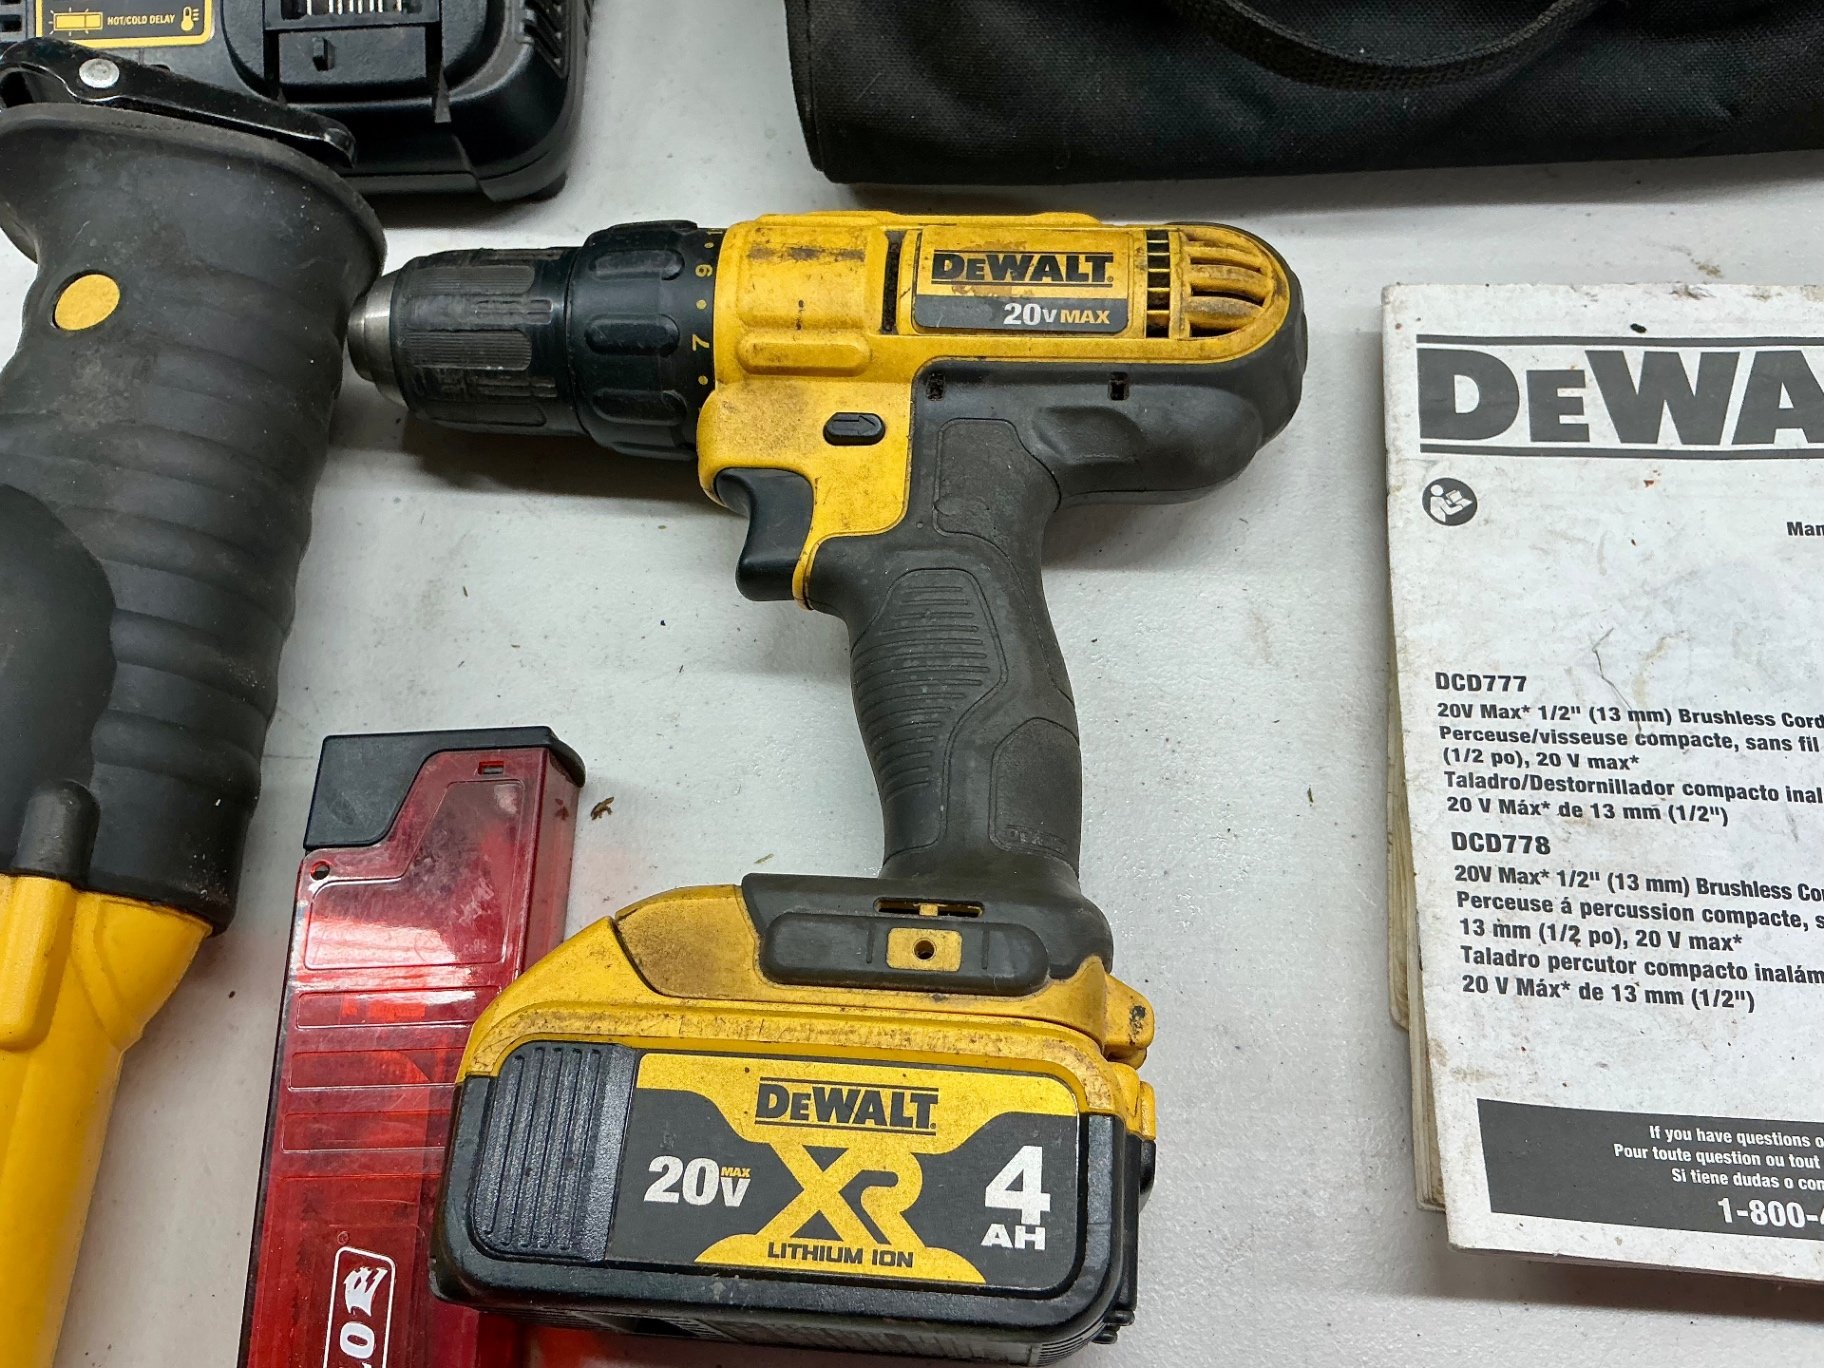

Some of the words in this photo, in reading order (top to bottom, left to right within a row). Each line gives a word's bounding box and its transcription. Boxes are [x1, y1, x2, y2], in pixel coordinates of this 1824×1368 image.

[107, 15, 147, 25] HOT/COLD
[150, 14, 175, 24] DELAY
[695, 264, 713, 278] 9
[931, 252, 1114, 284] DEWALT
[1003, 303, 1057, 326] 20V
[1060, 309, 1110, 325] MAX
[692, 334, 710, 351] 7
[1416, 347, 1824, 446] DEWA
[1435, 672, 1528, 693] DCD777
[1437, 702, 1474, 720] 20V
[1589, 706, 1621, 725] (13
[1628, 708, 1673, 727] mm)
[1679, 708, 1776, 728] Brushless
[1439, 725, 1628, 747] Perceuse/visseuse
[1635, 732, 1740, 753] compacte,
[1746, 736, 1793, 752] sans
[1798, 734, 1820, 753] fil
[1443, 747, 1484, 767] (1/2
[1491, 751, 1531, 769] po),
[1537, 751, 1562, 768] 20
[1564, 752, 1580, 769] V
[1444, 770, 1676, 797] Taladro/Destornillador
[1682, 781, 1780, 803] compacto
[1447, 796, 1472, 813] 20
[1476, 798, 1492, 814] V
[1559, 801, 1584, 819] de
[1591, 802, 1616, 820] 13
[1623, 807, 1662, 821] mm
[1667, 804, 1730, 828] (1/2")
[1451, 831, 1552, 856] DCD778
[1454, 865, 1492, 883] 20V
[1607, 872, 1640, 894] (13
[1645, 875, 1690, 898] mm)
[1696, 877, 1793, 901] Brushless
[1457, 890, 1554, 914] Perceuse
[1560, 897, 1573, 914] á
[1580, 900, 1695, 924] percussion
[1701, 908, 1809, 931] compacte,
[1460, 918, 1485, 937] 13
[1492, 919, 1531, 940] mm
[1538, 922, 1581, 945] (1/2
[1588, 927, 1629, 950] po),
[1635, 930, 1662, 949] 20
[1667, 931, 1682, 949] V
[1460, 945, 1540, 969] Taladro
[1548, 952, 1637, 975] percutor
[1644, 959, 1748, 983] compacto
[1462, 975, 1489, 994] 20
[1494, 977, 1509, 995] V
[1579, 982, 1604, 1002] de
[1611, 984, 1637, 1004] 13
[1644, 989, 1684, 1006] mm
[1691, 988, 1755, 1014] (1/2")
[755, 1083, 939, 1130] DEWALT
[1649, 1125, 1662, 1140] If
[1665, 1128, 1692, 1144] you
[1696, 1127, 1732, 1144] have
[1736, 1131, 1811, 1148] questions
[1613, 1143, 1648, 1160] Pour
[1652, 1146, 1692, 1163] toute
[1696, 1150, 1761, 1167] question
[1765, 1154, 1785, 1168] ou
[1788, 1153, 1821, 1170] tout
[643, 1155, 751, 1208] 20V
[720, 1166, 751, 1178] MAX
[984, 1145, 1051, 1226] 4
[1671, 1168, 1686, 1184] Si
[1691, 1169, 1729, 1186] tiene
[1733, 1171, 1780, 1189] dudas
[1783, 1176, 1794, 1189] o
[755, 1141, 925, 1248] XR
[1717, 1197, 1824, 1228] 1-800-
[980, 1223, 1046, 1251] AH
[768, 1242, 863, 1265] LITHIUM
[871, 1249, 914, 1268] ION
